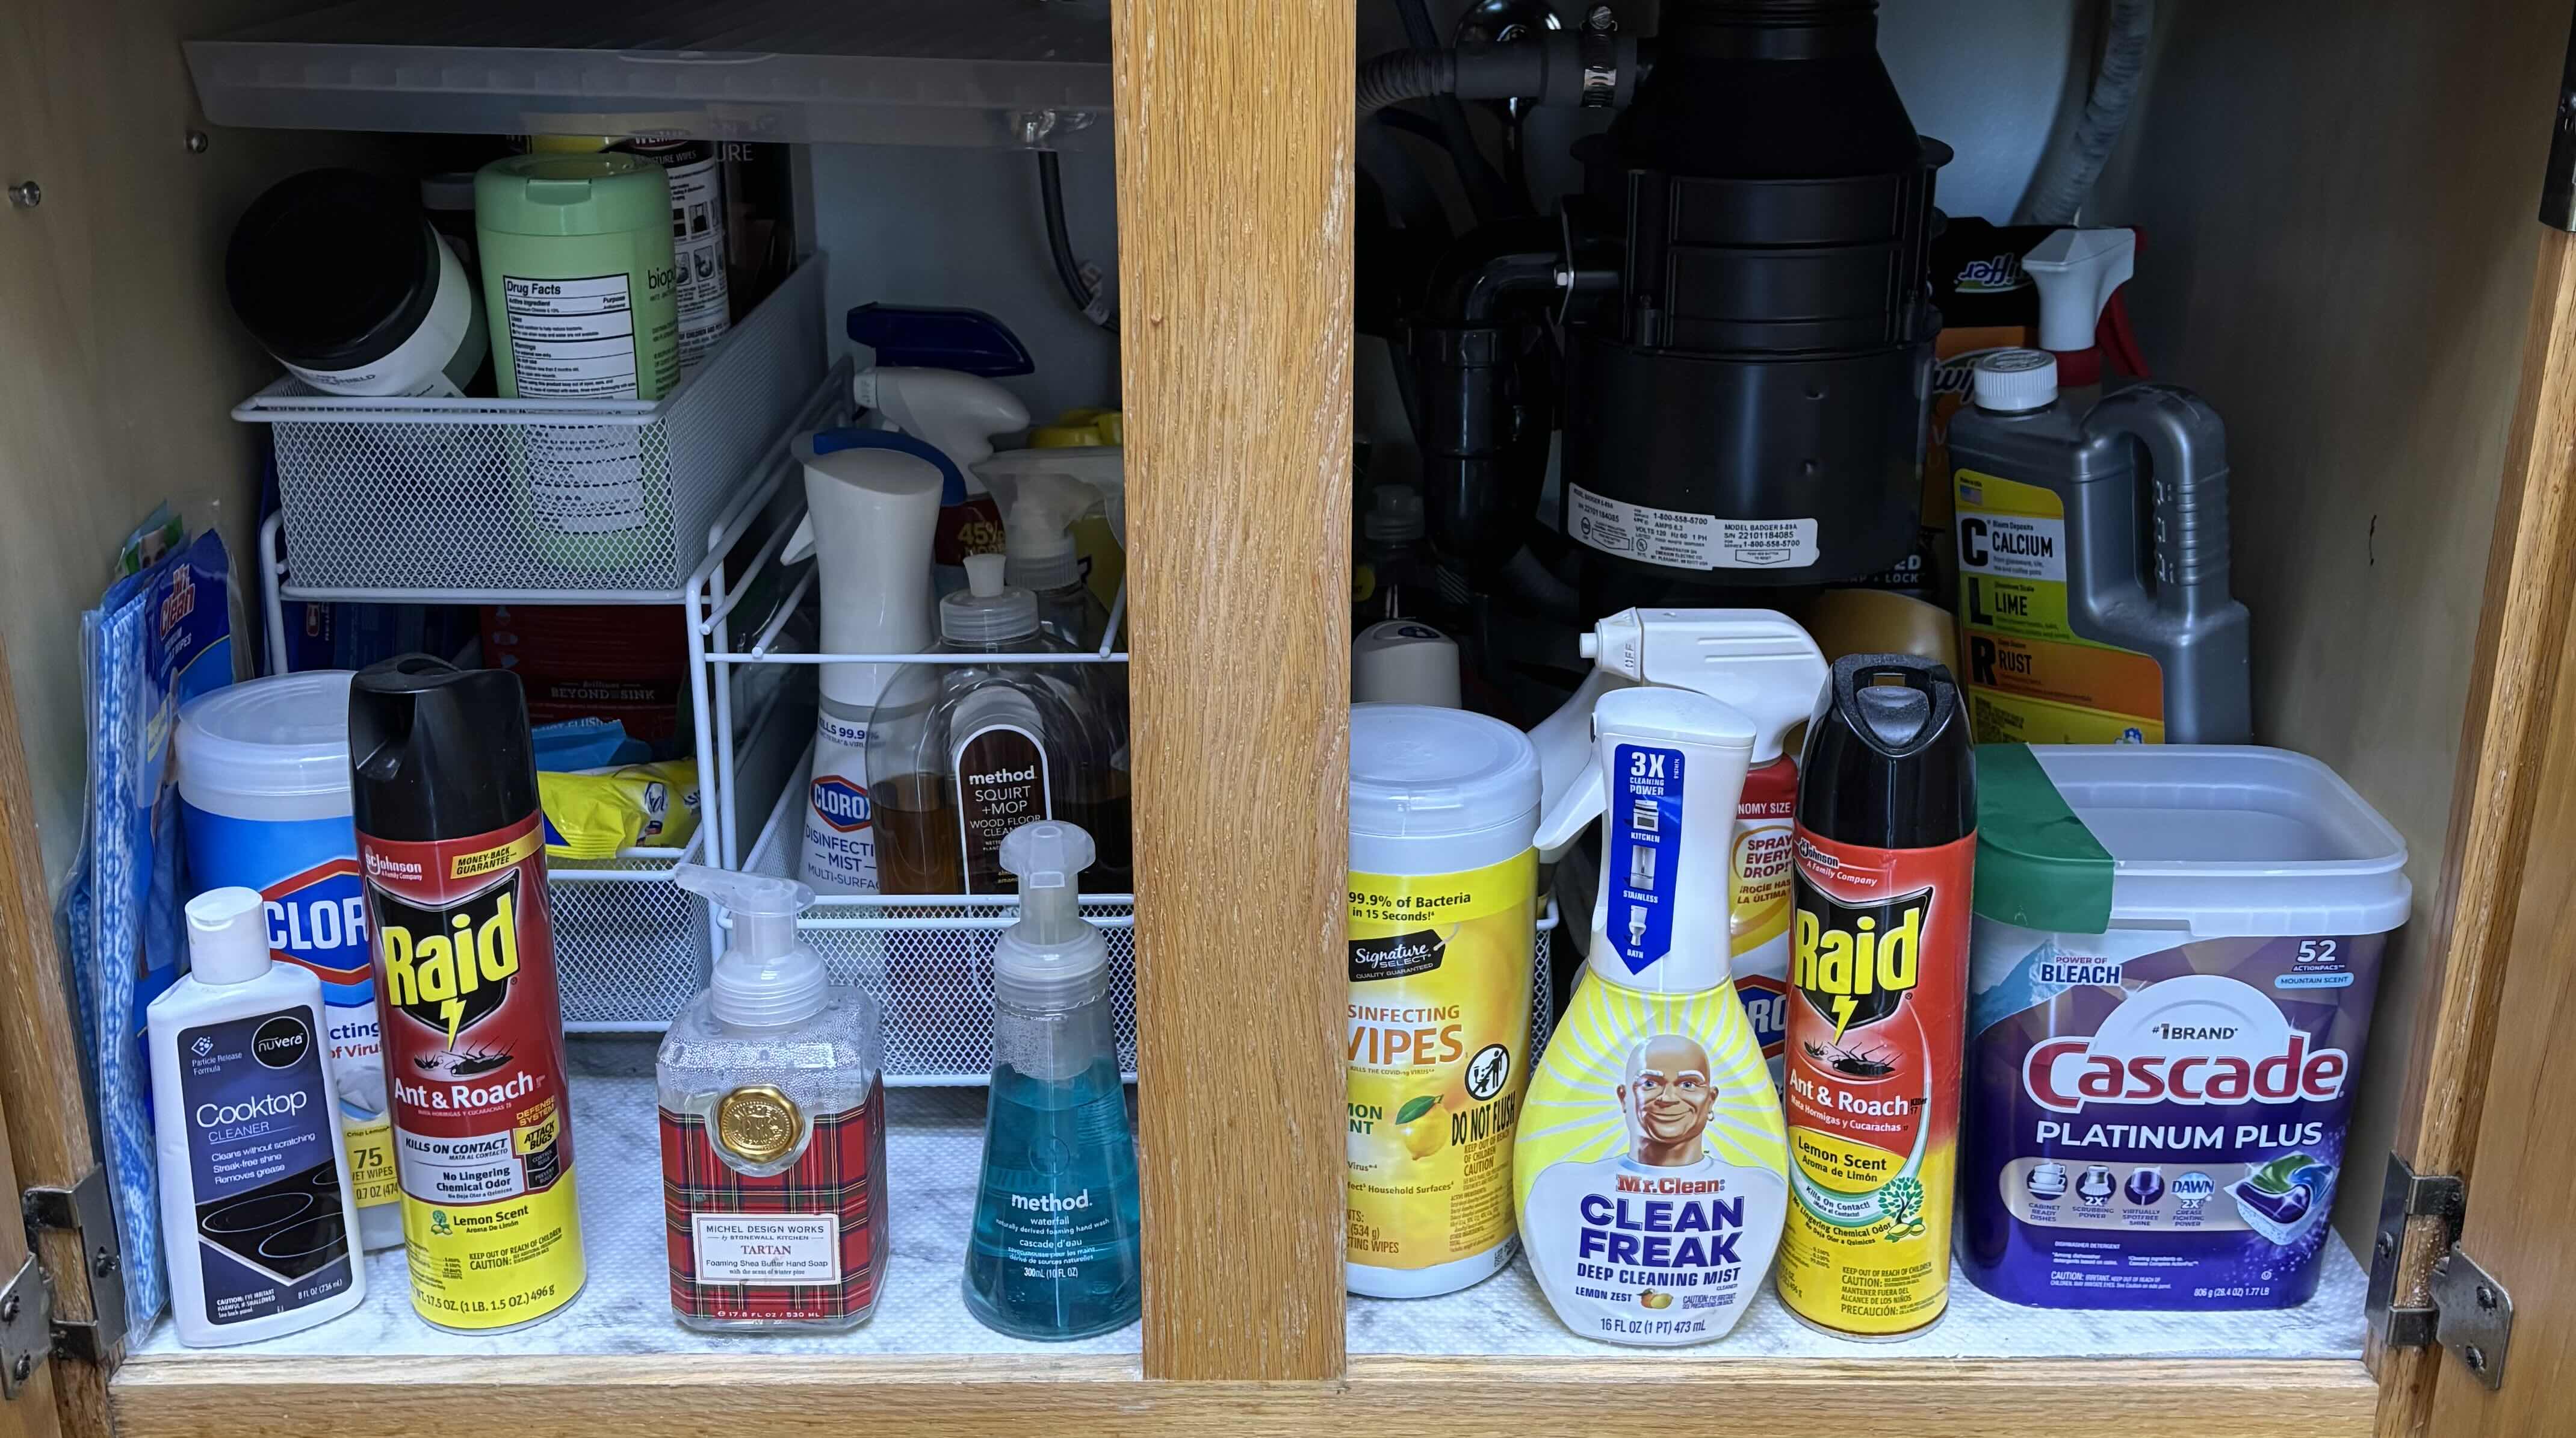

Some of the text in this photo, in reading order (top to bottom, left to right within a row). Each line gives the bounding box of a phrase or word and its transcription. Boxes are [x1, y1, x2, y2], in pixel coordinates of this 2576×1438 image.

[507, 280, 561, 296] Drug Facts
[1961, 518, 1988, 566] C
[1992, 532, 2053, 558] CALCIUM
[1968, 577, 1993, 626] L
[1995, 592, 2028, 616] LIME
[1971, 636, 1998, 686] R
[1998, 649, 2032, 675] RUST
[620, 689, 655, 699] SINK
[1631, 752, 1664, 778] 3X
[1630, 777, 1664, 786] CLEANING
[1630, 786, 1664, 796] POWER
[975, 786, 1031, 802] SQUIRT
[1770, 802, 1791, 813] SIZE
[970, 814, 1041, 828] WOOD FLOOR
[1631, 832, 1660, 843] KITCHEN
[1748, 835, 1793, 851] SPRAY
[457, 856, 510, 875] GUARANTEE
[458, 846, 510, 866] MONEY-BACK
[829, 852, 862, 872] MIST
[1746, 848, 1792, 864] EVERY
[1813, 863, 1877, 886] Family Company
[1348, 892, 1471, 908] 99.9% of Bacteria
[1623, 890, 1658, 903] STAINLESS
[1353, 907, 1378, 919] in 15
[381, 891, 519, 1006] Raid
[1355, 944, 1429, 968] Signature
[1627, 949, 1644, 959] BATH
[1794, 908, 1920, 995] Raid
[2297, 940, 2336, 963] 52
[1379, 954, 1427, 968] SELECT
[1387, 963, 1434, 976] GUARANTEED
[2041, 964, 2120, 984] BLEACH
[258, 1035, 303, 1052] nuvera
[2029, 1035, 2344, 1109] Cascade
[395, 1071, 533, 1109] Ant & Roach
[1790, 1068, 1909, 1116] Ant & Roach
[196, 1091, 306, 1127] Cooktop
[516, 1095, 555, 1121] DEFENSE
[519, 1103, 554, 1126] SYSTEM
[1452, 1091, 1516, 1146] DO NOT FLUSH
[208, 1121, 270, 1142] CLEANER
[524, 1121, 554, 1144] ATTACK
[530, 1133, 553, 1150] BUGS
[2036, 1120, 2323, 1150] PLATINUM PLUS
[211, 1133, 315, 1162] Cleans without scratching
[406, 1138, 508, 1154] KILLS ON CONTACT
[1798, 1135, 1887, 1171] Lemon Scent
[213, 1153, 282, 1173] Streak-free shine
[353, 1147, 383, 1170] 75
[1464, 1156, 1494, 1177] CAUTION
[1803, 1155, 1877, 1182] Aroma de Limón
[215, 1164, 285, 1185] Removes grease
[368, 1166, 393, 1179] WIPES
[443, 1167, 510, 1181] No Lingering
[436, 1178, 511, 1192] Chemical Odor
[2172, 1180, 2214, 1193] DAWN
[453, 1205, 529, 1226] Lemon Scent
[1030, 1216, 1070, 1226] waterfall
[1581, 1193, 1744, 1232] CLEAN
[995, 1218, 1018, 1232] naturally
[1020, 1226, 1045, 1235] derived
[1076, 1223, 1092, 1233] hand
[1094, 1218, 1109, 1229] wash
[1800, 1208, 1891, 1238] Lingering Chemical Odor
[469, 1251, 485, 1260] KEEP
[486, 1250, 499, 1259] OUT
[500, 1248, 509, 1256] OF
[510, 1243, 530, 1254] REACH
[539, 1227, 562, 1244] CHILDREN
[740, 1245, 791, 1255] TARTAN
[1371, 1242, 1399, 1254] WIPES
[1579, 1227, 1743, 1268] FREAK
[470, 1257, 512, 1270] CAUTION:
[706, 1259, 737, 1268] Foaming
[1577, 1263, 1741, 1286] DEEP CLEANING MIST
[1842, 1275, 1883, 1288] CAUTION:
[1576, 1286, 1632, 1302] LEMON ZEST
[1841, 1304, 1898, 1316] PRECAUCIÓN:
[1600, 1318, 1706, 1335] 16 FL OZ (1 PT) 473 mL
